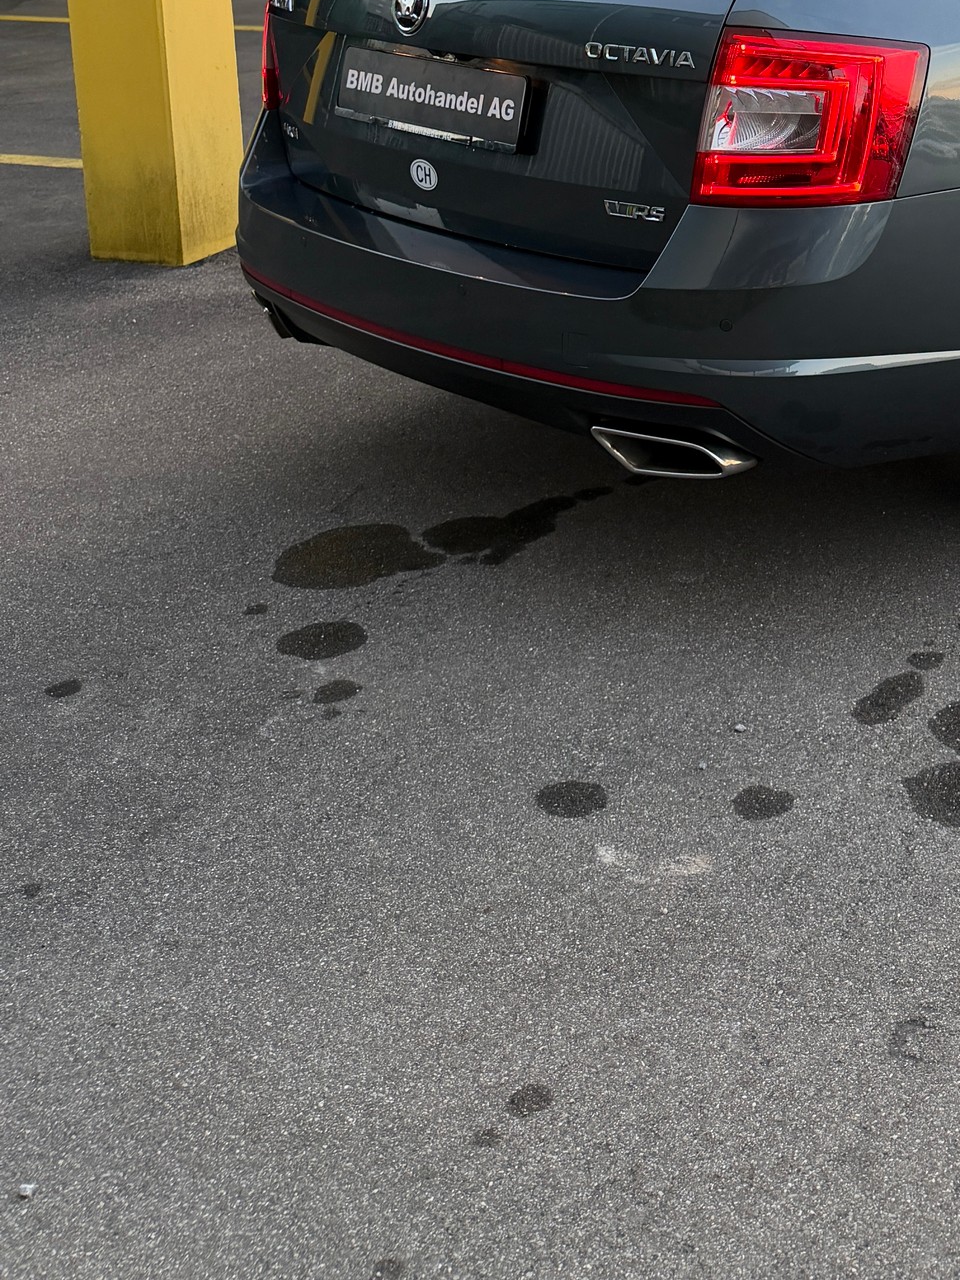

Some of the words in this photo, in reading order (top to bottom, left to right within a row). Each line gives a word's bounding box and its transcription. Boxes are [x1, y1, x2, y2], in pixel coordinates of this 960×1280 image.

[585, 41, 696, 69] OCTAVIA
[346, 69, 384, 95] BMB
[386, 77, 485, 115] Autohandel
[487, 97, 515, 121] AG
[415, 164, 432, 186] CH
